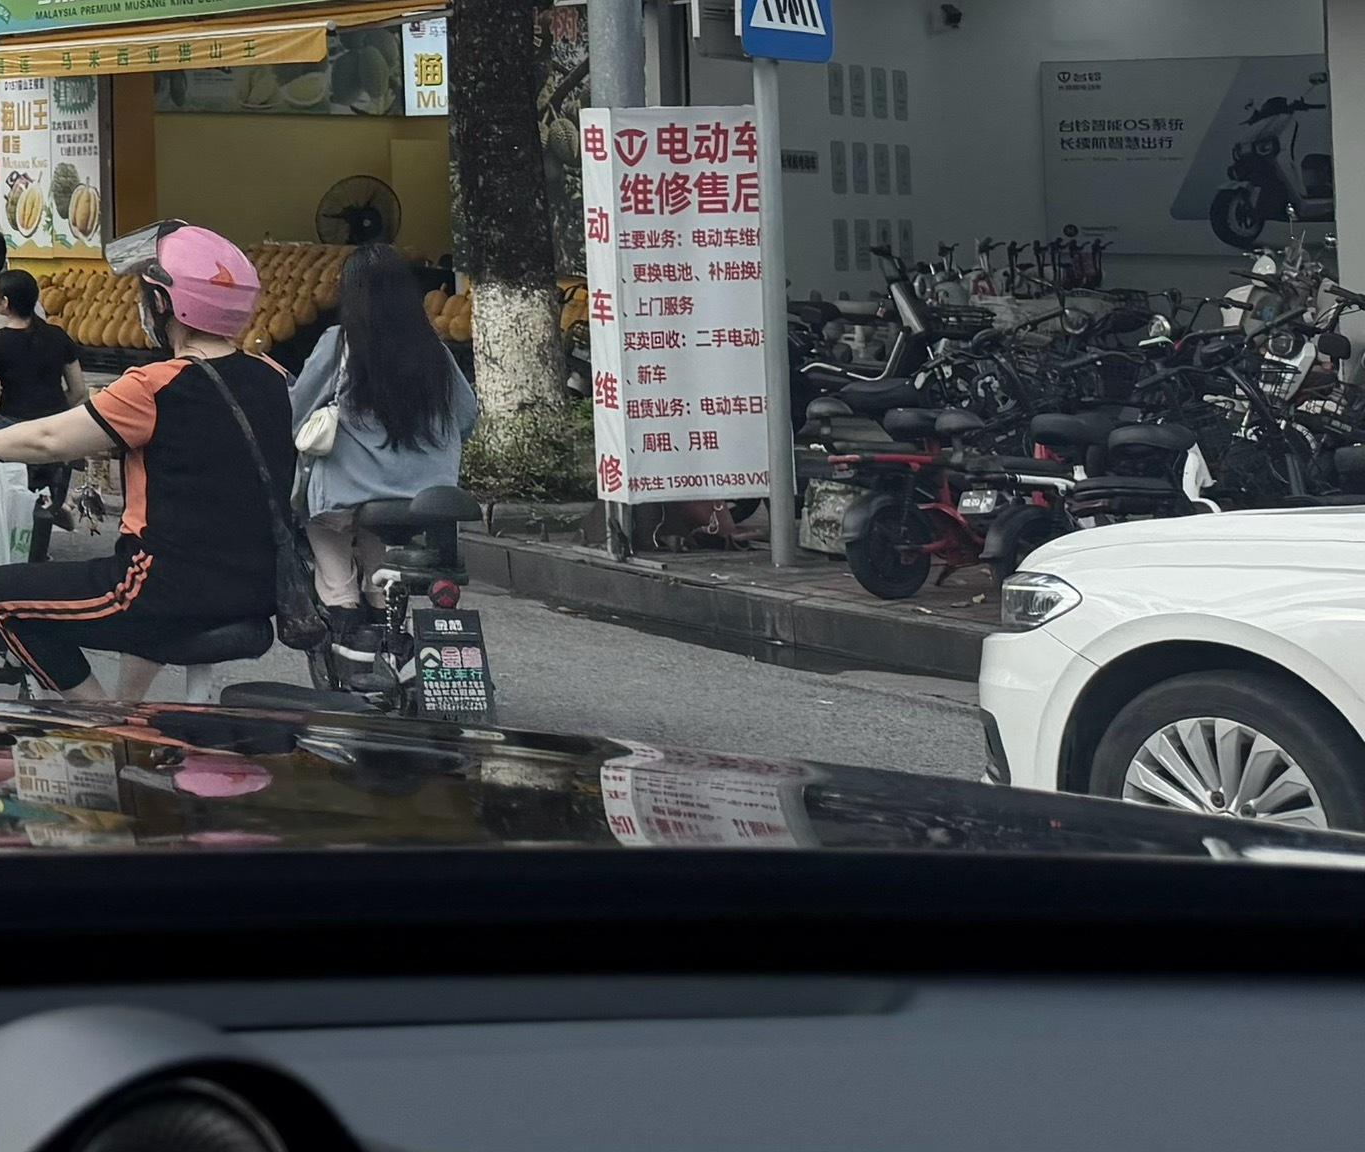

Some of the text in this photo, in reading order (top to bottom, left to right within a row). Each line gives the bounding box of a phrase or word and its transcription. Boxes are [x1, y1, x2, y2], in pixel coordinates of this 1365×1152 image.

[35, 7, 77, 21] MALAYSIA
[80, 2, 121, 16] PREMIUM
[1, 99, 48, 131] 猫山王
[657, 121, 757, 164] 电动车
[619, 171, 760, 215] 维修售后
[619, 227, 761, 249] 主要业务：电动车维
[583, 123, 623, 493] 电动车维修
[623, 328, 764, 352] 买卖回收：二手电动
[626, 395, 767, 419] 租赁业务：电动车日
[628, 471, 768, 492] 林先生 15900118438 VX
